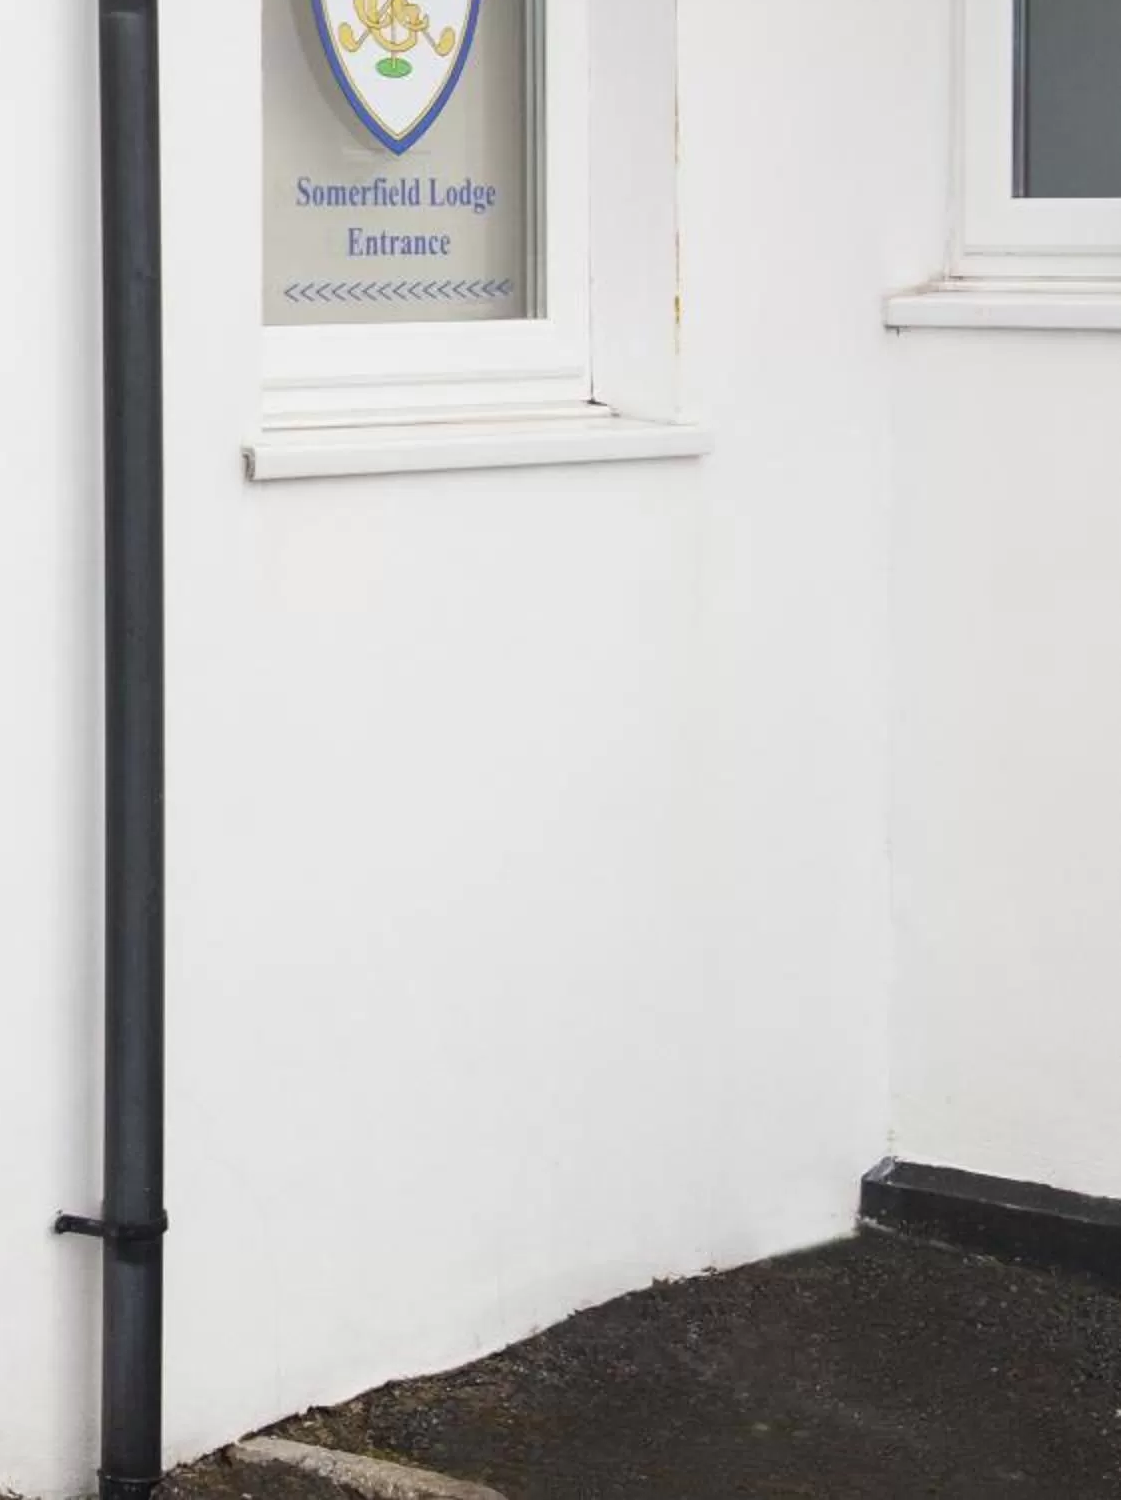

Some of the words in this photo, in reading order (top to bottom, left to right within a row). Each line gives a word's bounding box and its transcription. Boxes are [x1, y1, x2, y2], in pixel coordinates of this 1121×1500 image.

[296, 176, 420, 206] Somerfield
[429, 177, 496, 214] Lodge
[348, 227, 451, 256] Entrance
